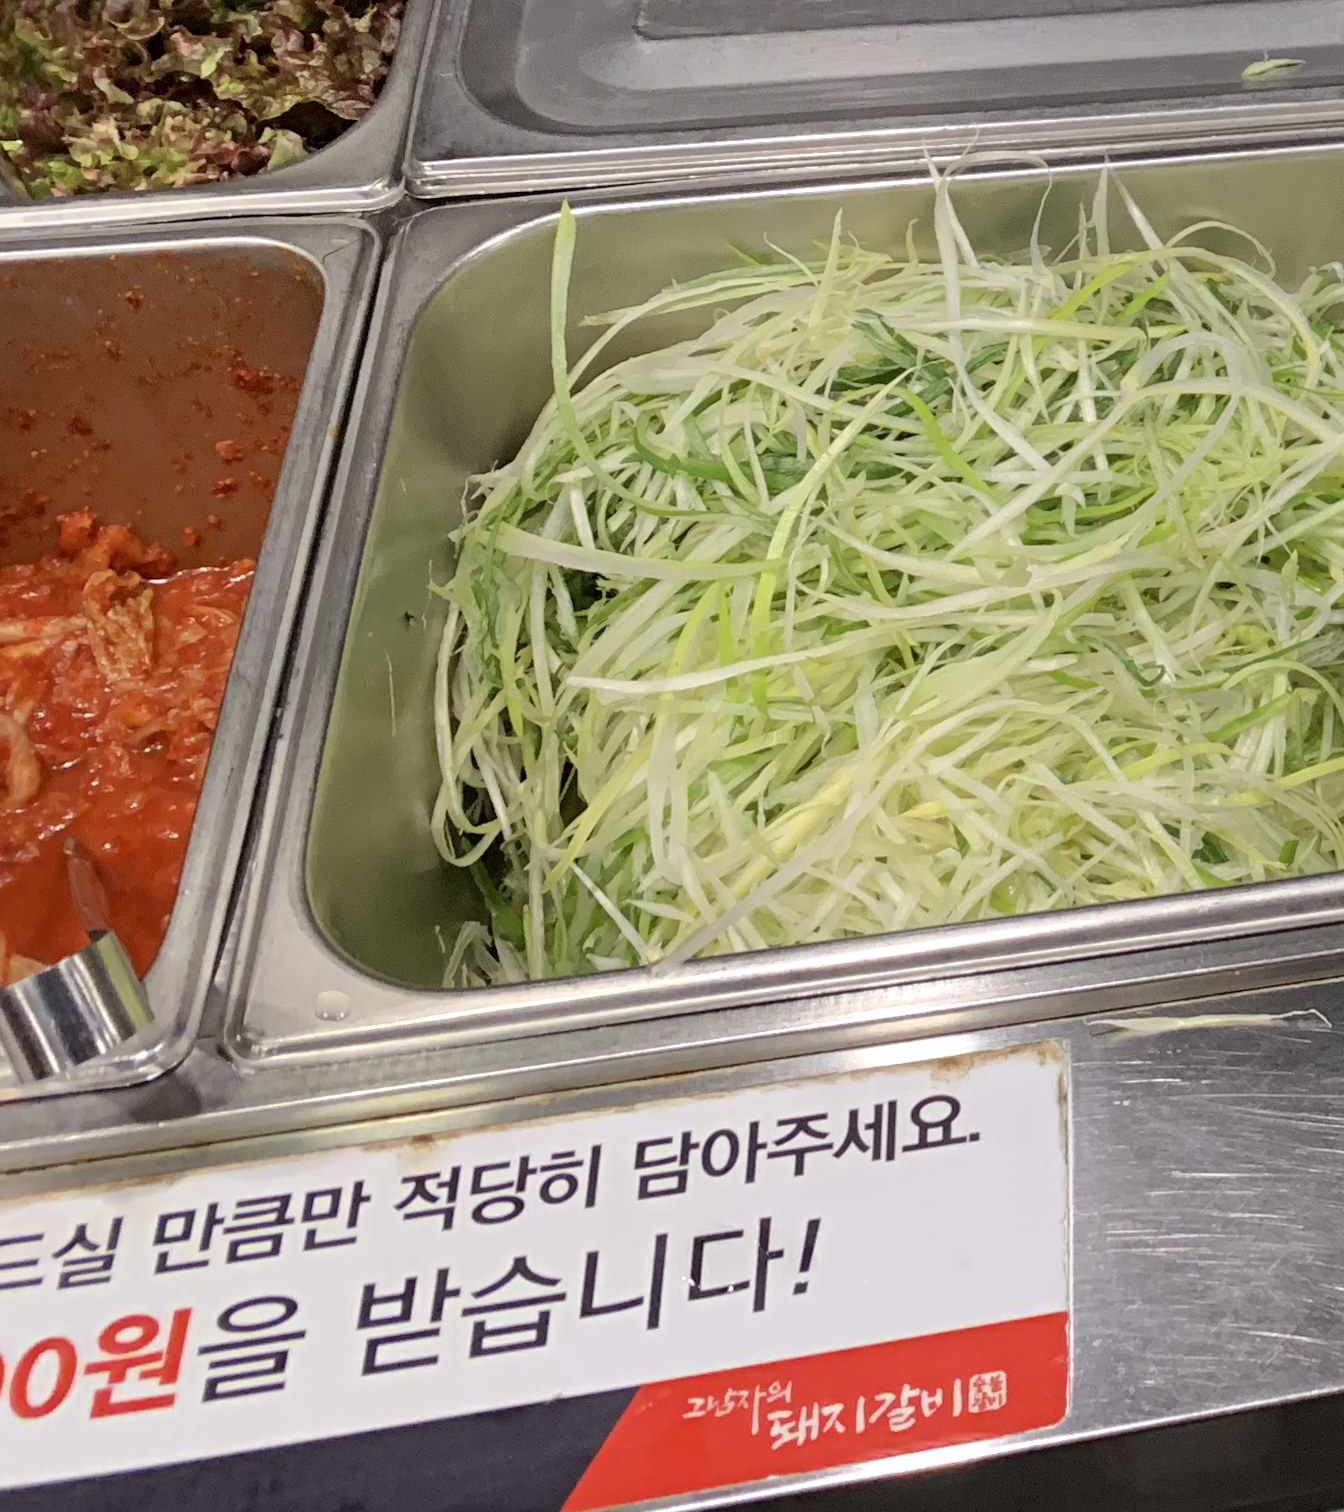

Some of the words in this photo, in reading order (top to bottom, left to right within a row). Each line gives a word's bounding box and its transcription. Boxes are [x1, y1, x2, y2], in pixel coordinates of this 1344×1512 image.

[151, 1179, 371, 1276] 만큼만
[393, 1144, 600, 1231] 적당히
[631, 1093, 981, 1199] 담아주세요.
[0, 1295, 307, 1419] 0원을
[356, 1216, 822, 1377] 받습니다!
[767, 1377, 963, 1451] 돼지갈비
